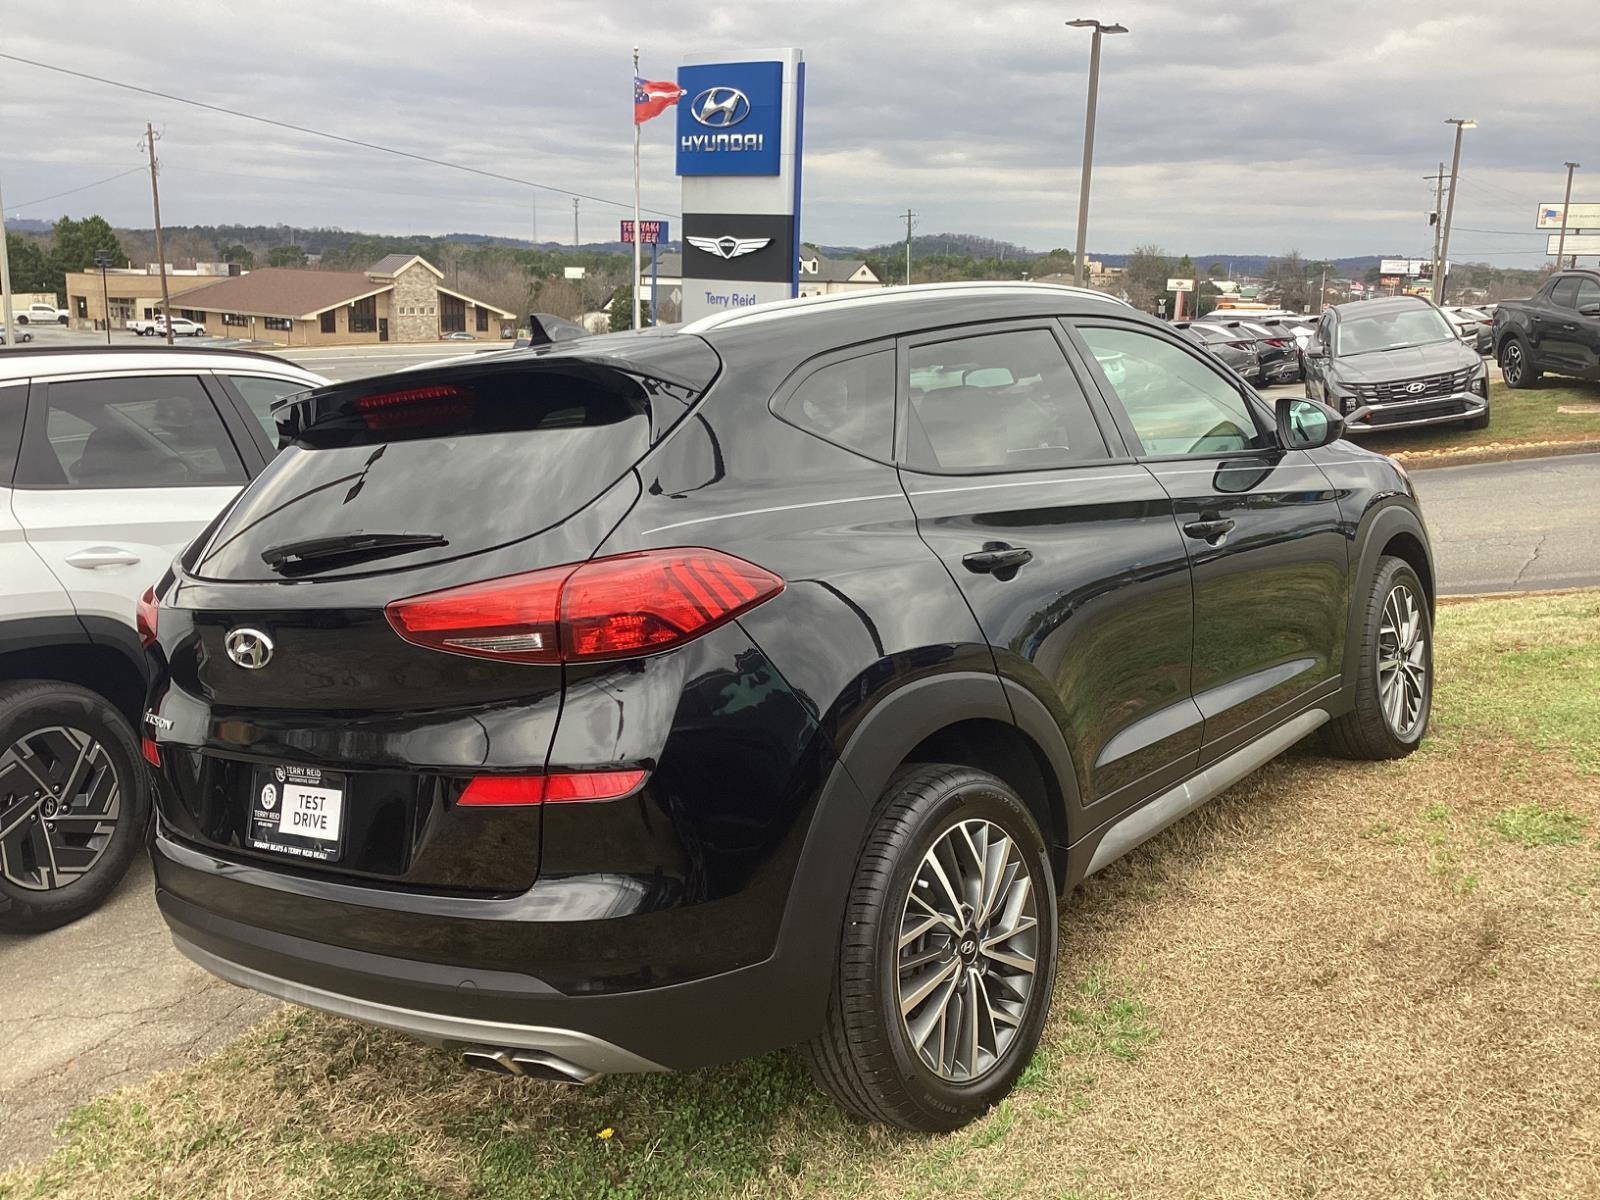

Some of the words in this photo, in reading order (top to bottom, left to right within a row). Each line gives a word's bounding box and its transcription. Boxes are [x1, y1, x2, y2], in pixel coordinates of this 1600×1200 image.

[681, 133, 764, 152] HYUNDAI
[622, 222, 660, 233] TEYAKI
[704, 291, 730, 308] Terry
[732, 293, 756, 306] Reid
[286, 766, 305, 776] TERRY
[306, 768, 322, 777] REID
[298, 794, 326, 812] TEST
[293, 811, 328, 830] DRIVE
